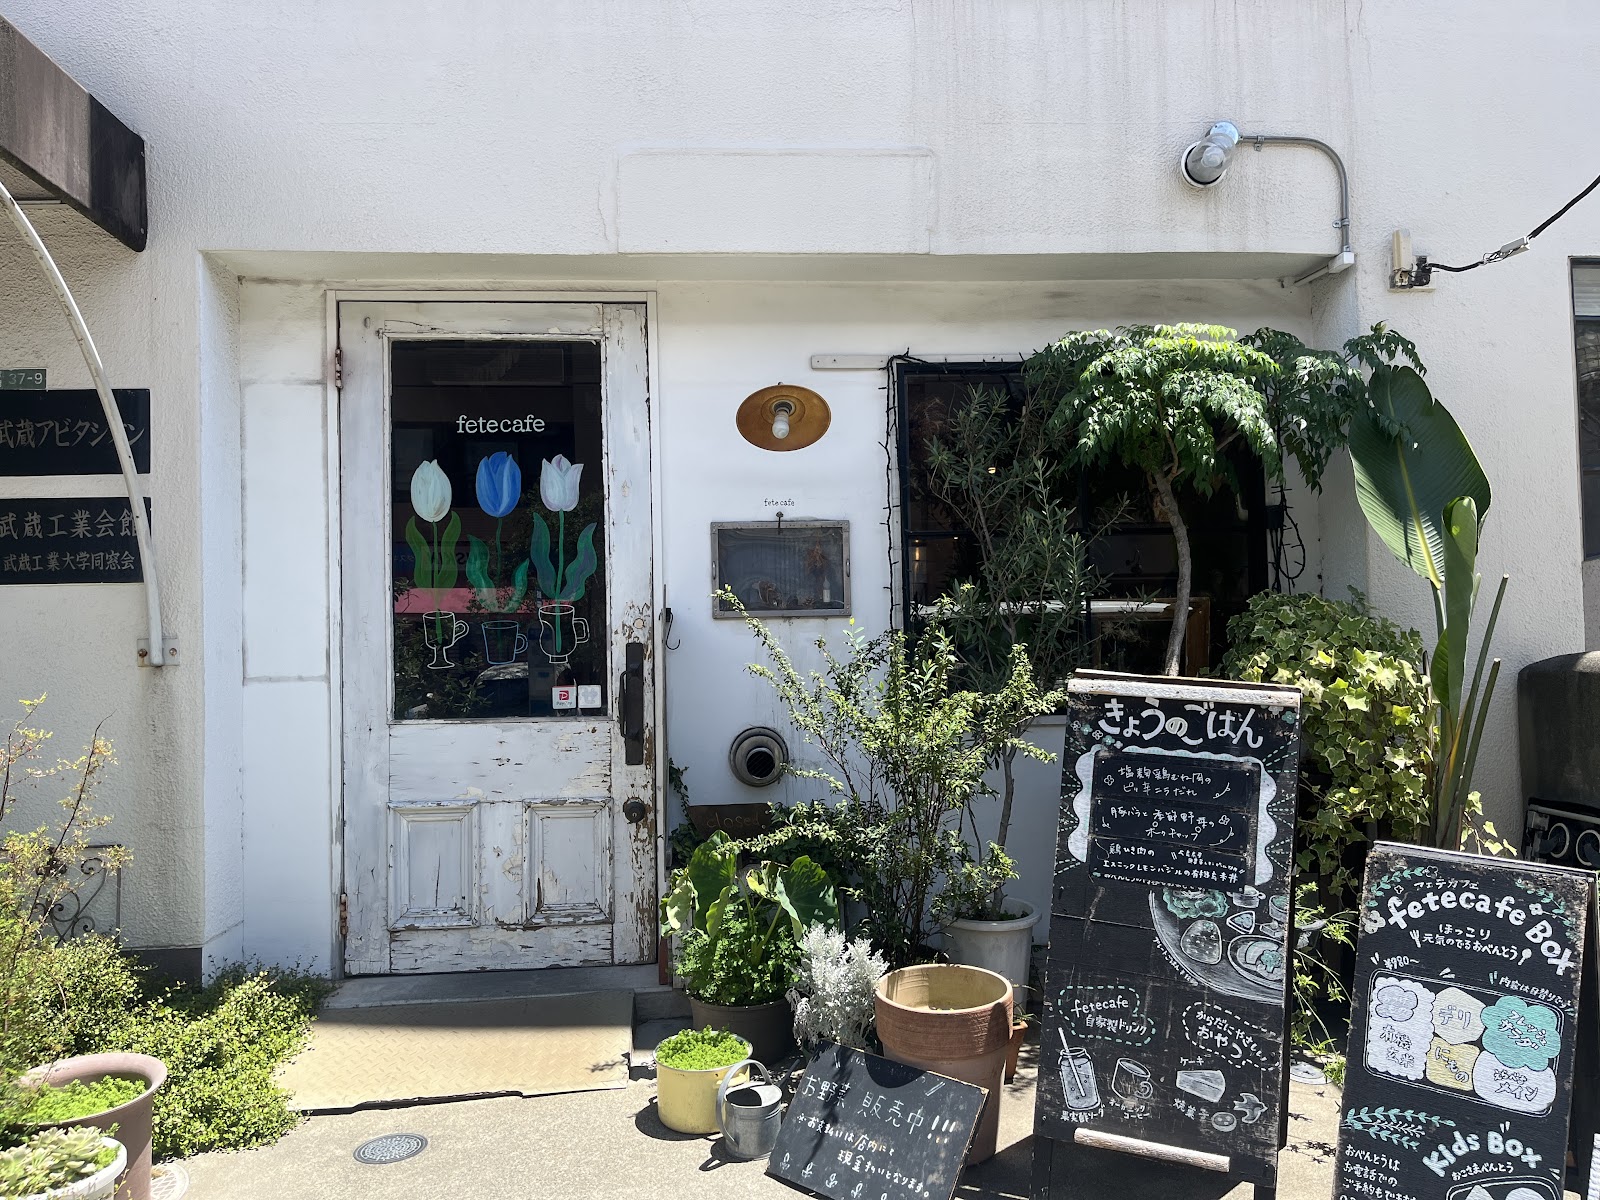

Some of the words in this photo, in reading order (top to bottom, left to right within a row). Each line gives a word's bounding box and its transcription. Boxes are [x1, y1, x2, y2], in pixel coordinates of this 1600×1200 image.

[9, 372, 43, 385] 37-9
[456, 414, 545, 433] fetecafe
[3, 549, 136, 572] 武蔵工業大学同窓会
[1098, 697, 1264, 749] きょうのごはん
[1387, 891, 1527, 930] fetecafe
[1524, 919, 1577, 977] Box
[1438, 923, 1492, 941] ほっこり
[1422, 933, 1519, 961] 元気のでるおべんとう
[1070, 995, 1129, 1018] fetecafe
[1438, 1004, 1472, 1030] デリ
[1086, 1014, 1147, 1036] 自家製ドリンク
[1498, 1018, 1540, 1051] サラダ
[1197, 1024, 1243, 1059] おやつ
[1179, 1055, 1206, 1067] ケーキ
[1494, 1081, 1539, 1102] メイン
[1344, 1143, 1401, 1172] おべんとうは
[1422, 1130, 1482, 1178] Kids
[1487, 1130, 1543, 1169] Box
[1343, 1161, 1398, 1188] お電話での
[1451, 1161, 1515, 1182] おこさまべんとう
